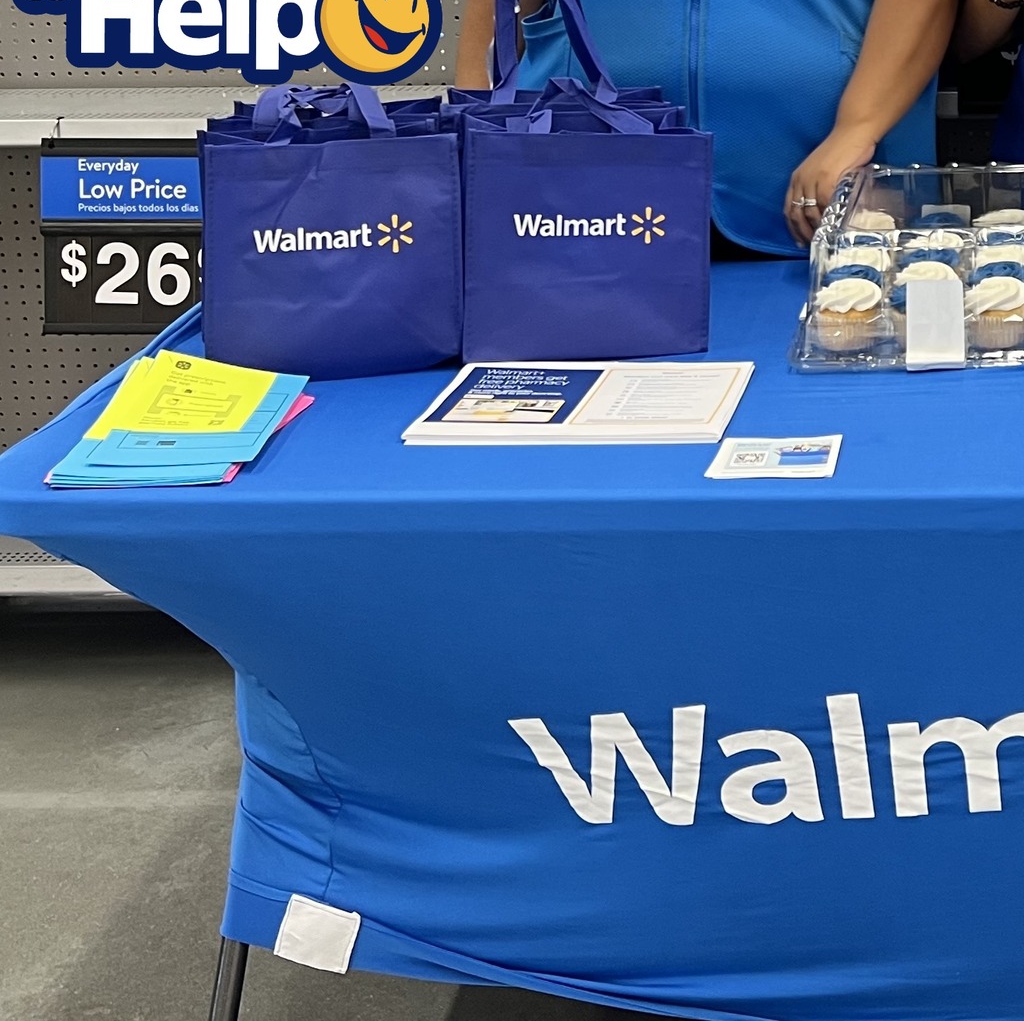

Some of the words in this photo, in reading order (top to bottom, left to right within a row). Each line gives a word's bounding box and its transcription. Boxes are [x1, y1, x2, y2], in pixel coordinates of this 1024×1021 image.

[78, 159, 139, 175] Everyday
[79, 178, 123, 199] Low
[130, 178, 187, 199] Price
[78, 203, 111, 212] Precios
[113, 202, 136, 214] bajos
[138, 203, 164, 212] todos
[166, 203, 179, 212] los
[513, 213, 627, 238] Walmart
[253, 223, 373, 254] Walmart
[60, 240, 203, 306] $26
